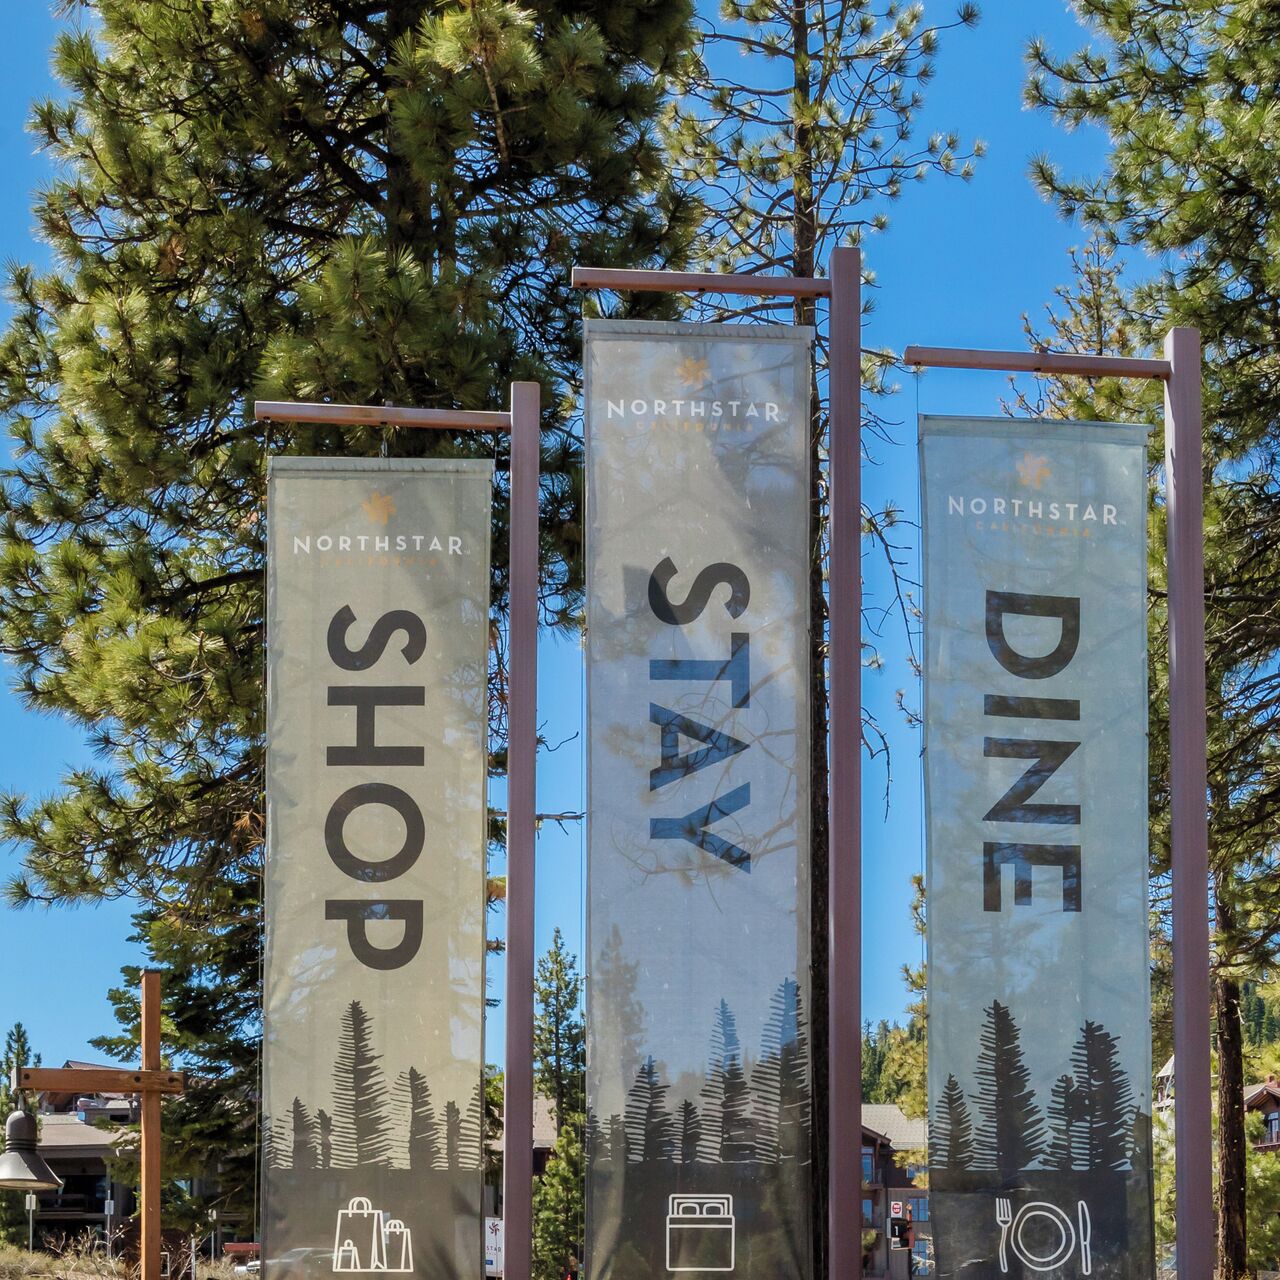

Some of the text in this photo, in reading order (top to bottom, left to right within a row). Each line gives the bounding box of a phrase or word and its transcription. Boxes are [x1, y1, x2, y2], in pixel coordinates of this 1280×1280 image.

[607, 399, 780, 423] NORTHSTAR
[293, 535, 463, 555] NORTHSTAR
[949, 495, 1118, 526] NORTHSTAR
[325, 603, 427, 970] SHOP
[648, 556, 751, 874] STAY
[982, 590, 1082, 913] DINE
